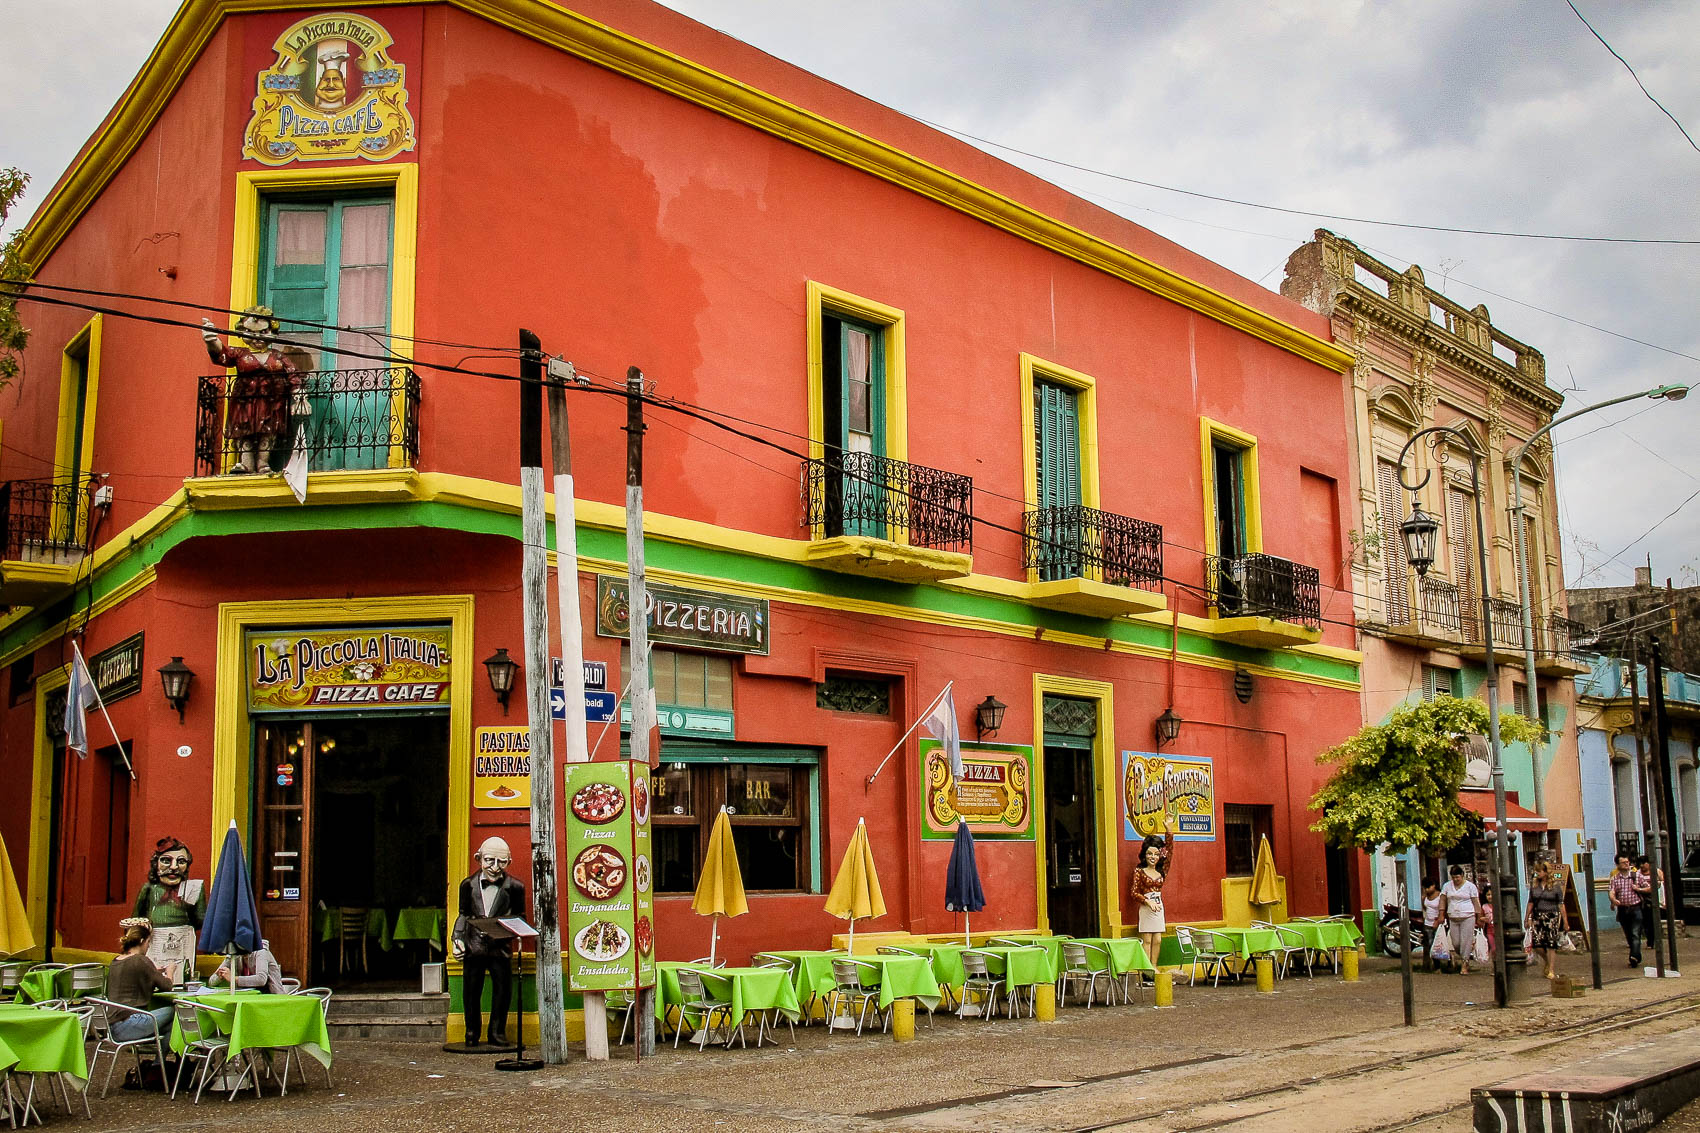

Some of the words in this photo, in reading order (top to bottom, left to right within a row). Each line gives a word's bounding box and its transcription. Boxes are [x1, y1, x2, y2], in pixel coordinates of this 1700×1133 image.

[285, 36, 307, 53] LA
[303, 22, 345, 41] PICCOLA
[344, 21, 375, 48] ITALIA
[279, 105, 329, 137] PIZZA
[334, 99, 383, 132] CAFE
[645, 590, 752, 638] PIZZERIA
[98, 649, 132, 690] CAFETERIA
[292, 637, 379, 691] PICCOLA
[384, 633, 440, 668] ITALIA
[558, 663, 603, 684] GALDI
[315, 686, 380, 702] PIZZA
[384, 684, 440, 700] CAFE
[480, 732, 530, 751] PASTAS
[476, 756, 531, 775] CASERAS
[962, 765, 1001, 780] PIZZA
[746, 780, 771, 799] BAR
[1133, 762, 1163, 816] PATIO
[583, 829, 616, 839] Pizzas
[571, 901, 631, 915] Empanadas
[577, 964, 629, 976] Ensaladas
